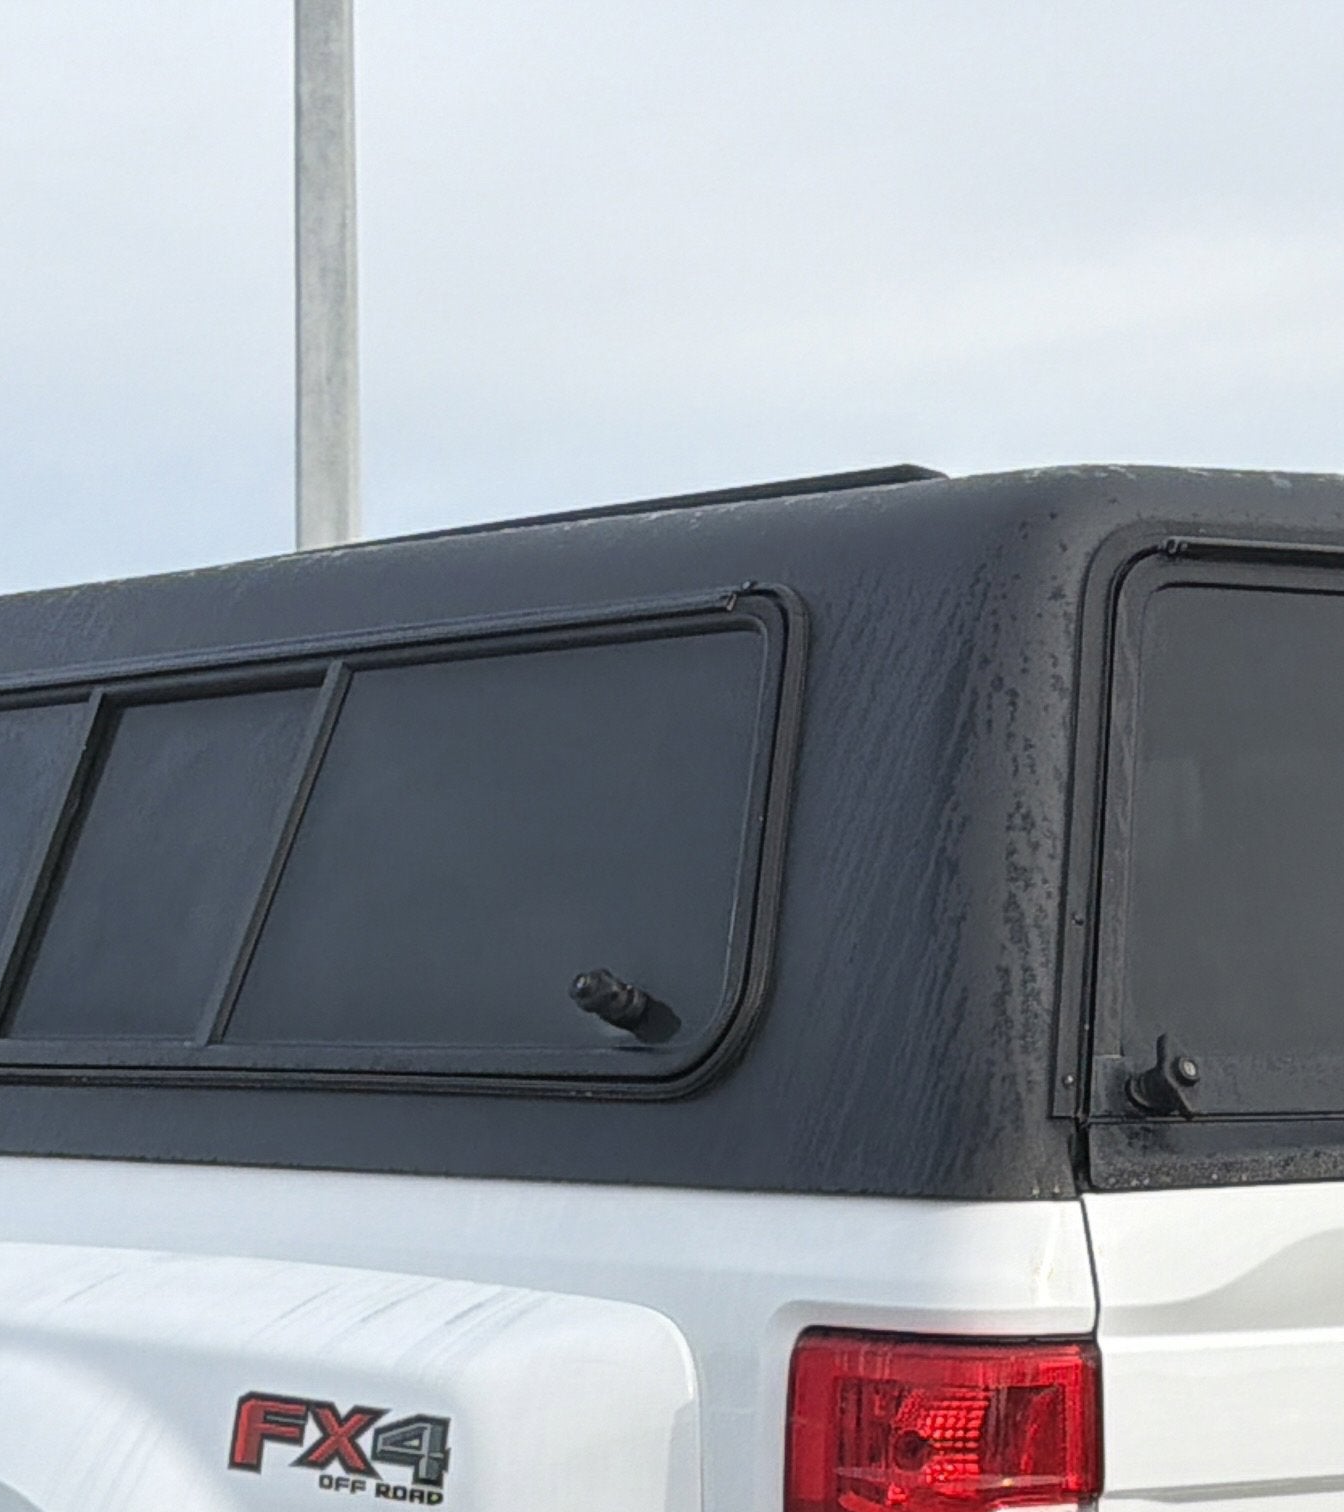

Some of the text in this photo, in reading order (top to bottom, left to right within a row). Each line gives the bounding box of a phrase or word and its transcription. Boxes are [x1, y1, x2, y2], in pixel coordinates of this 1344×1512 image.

[228, 1391, 451, 1489] FX4
[319, 1474, 444, 1506] OFF ROAD
